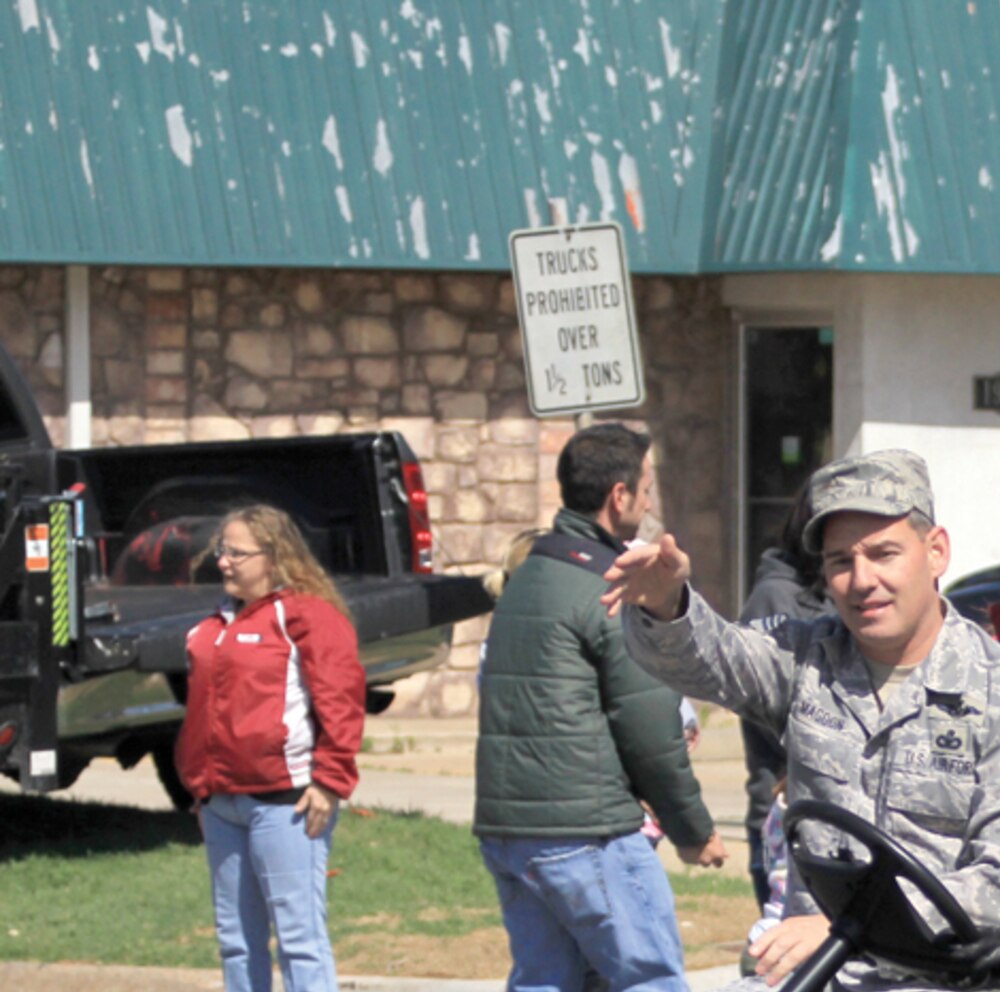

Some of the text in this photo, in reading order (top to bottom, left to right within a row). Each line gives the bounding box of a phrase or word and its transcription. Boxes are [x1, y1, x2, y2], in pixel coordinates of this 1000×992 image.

[536, 246, 599, 276] TRUCKS
[525, 283, 621, 316] PROHIBITED
[557, 324, 599, 352] OVER
[581, 361, 623, 388] TONS
